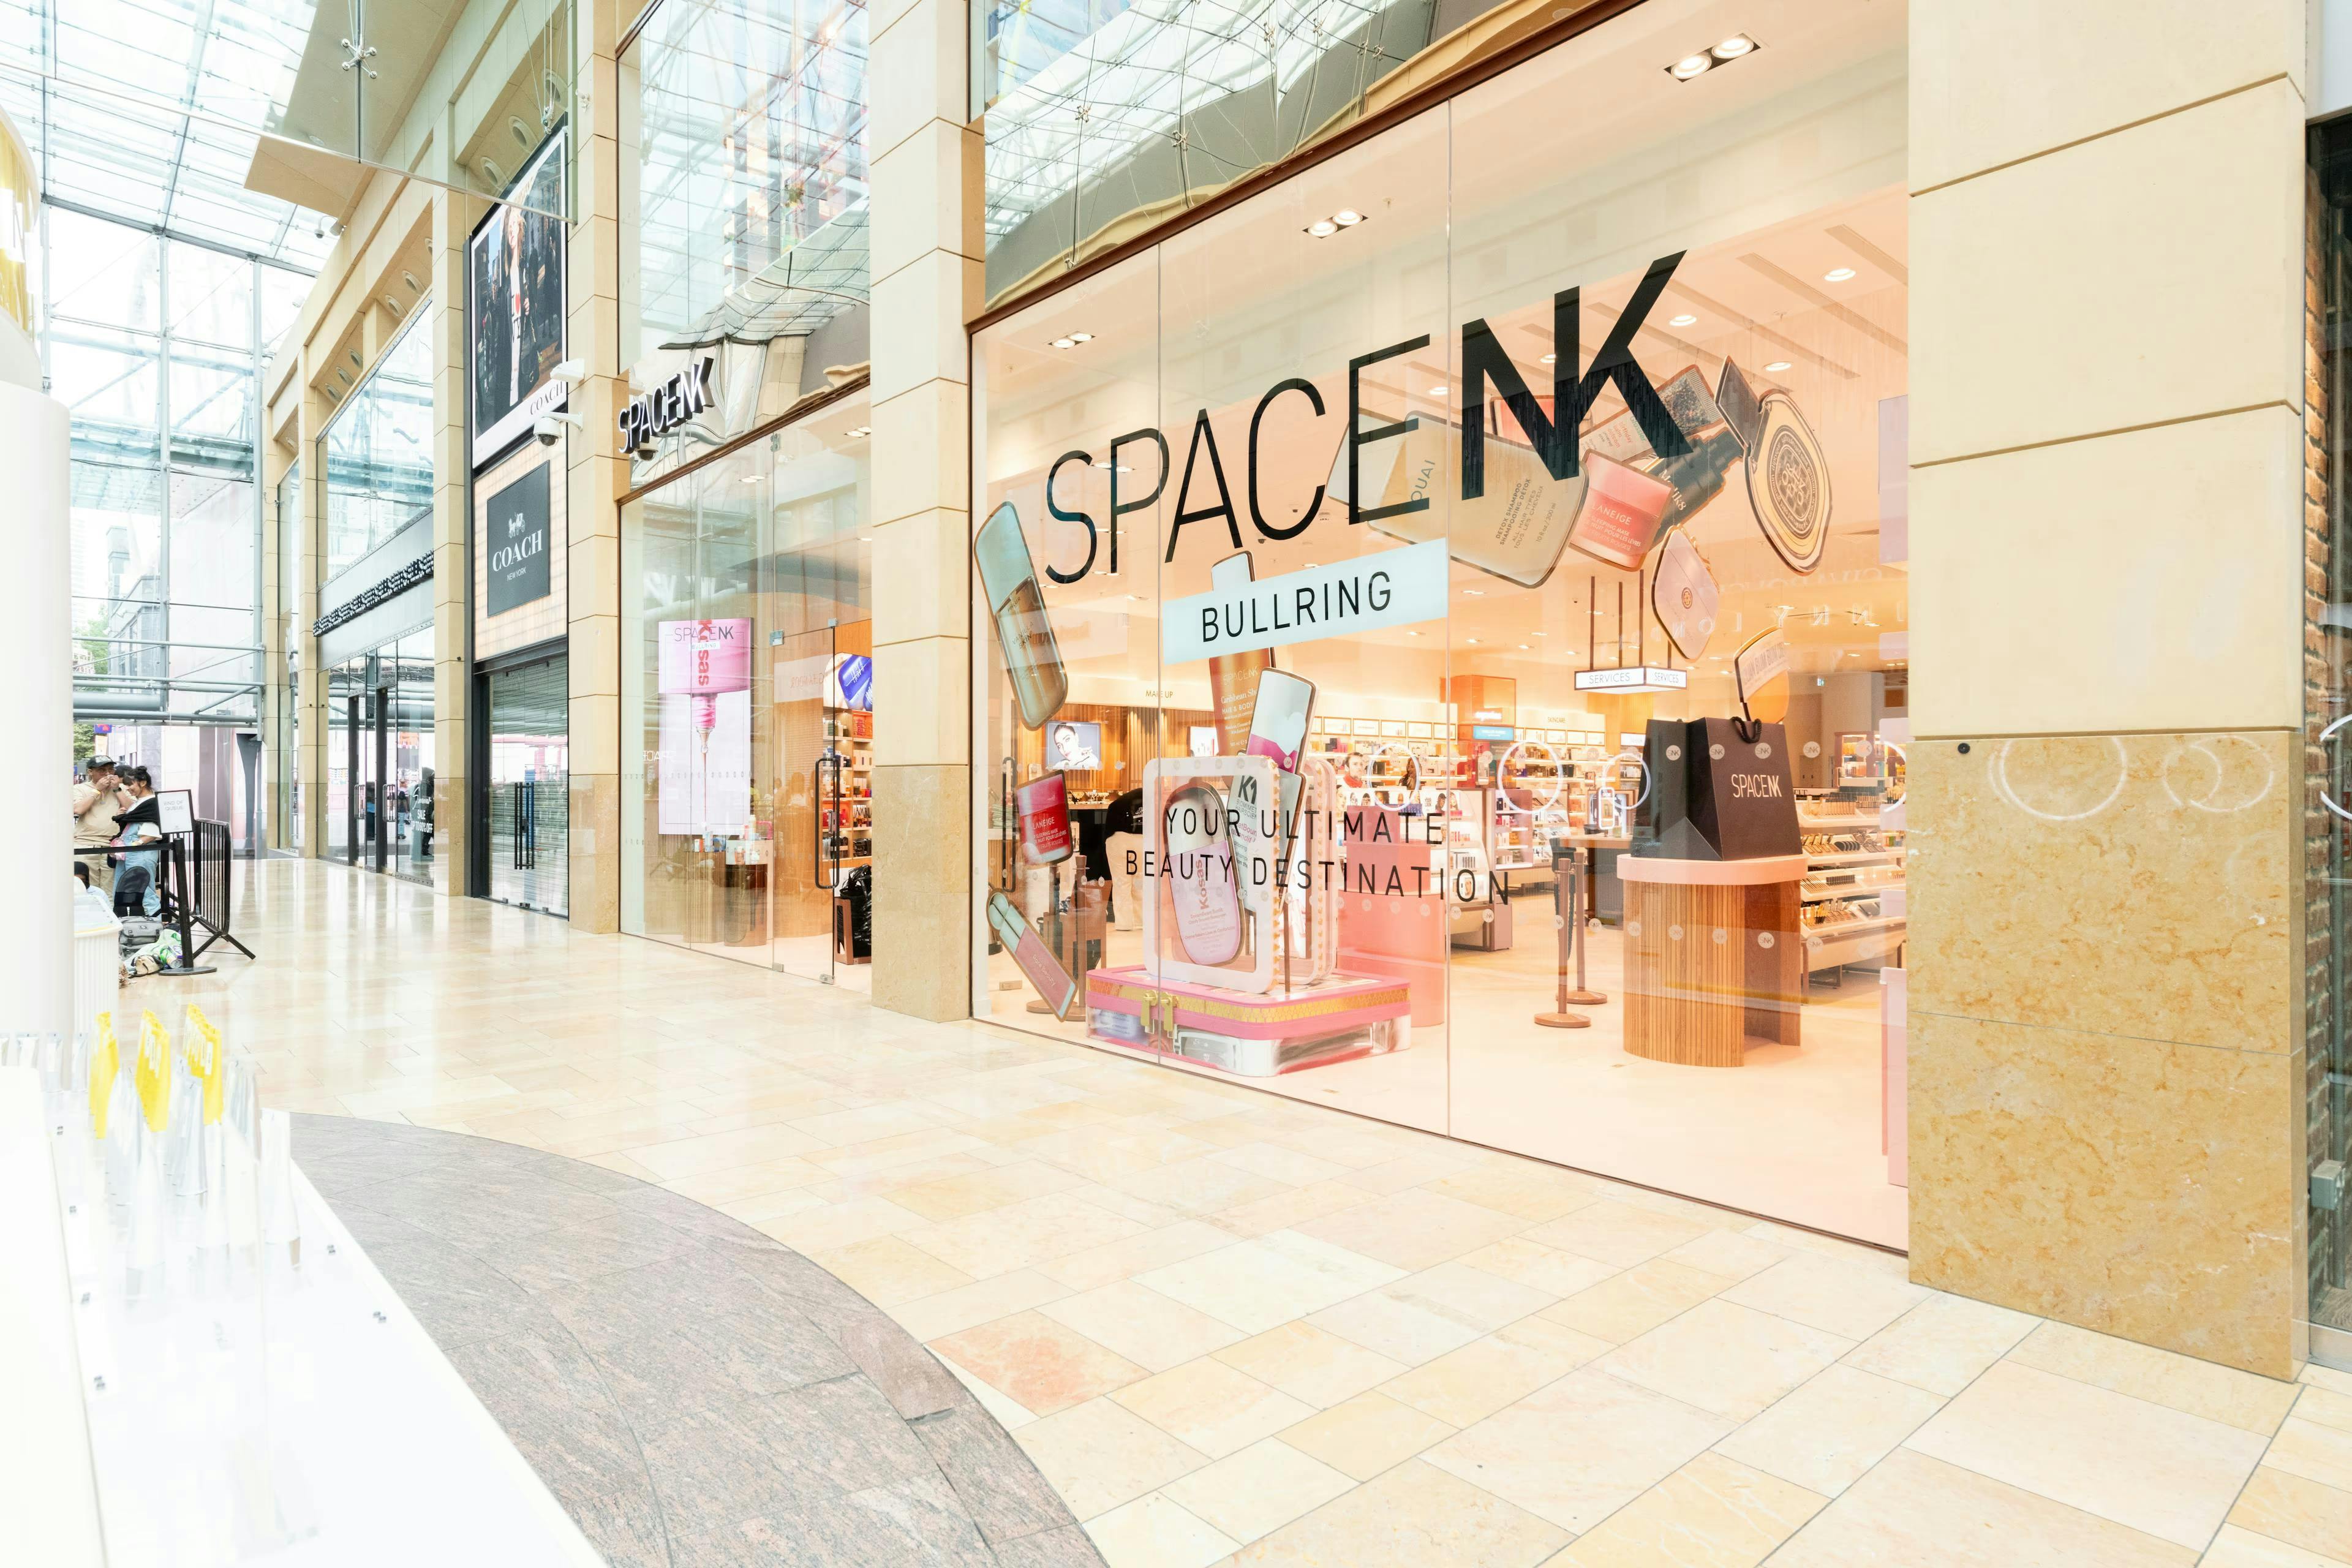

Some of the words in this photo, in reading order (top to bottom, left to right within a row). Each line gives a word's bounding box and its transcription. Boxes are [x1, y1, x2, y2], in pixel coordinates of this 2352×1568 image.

[530, 381, 563, 415] COACH
[619, 356, 710, 454] SPACENK
[1046, 250, 1693, 583] SPACENK
[1411, 459, 1435, 502] OUAI
[1496, 518, 1509, 539] DETOX
[1506, 483, 1522, 516] SHAMPOO
[1499, 502, 1522, 545] SHAMPOOING
[1513, 533, 1525, 549] TOUS
[1523, 518, 1532, 531] LES
[1529, 485, 1544, 516] CHEVEUX
[1519, 512, 1528, 528] HAIR
[1525, 490, 1537, 511] TYPES
[1593, 503, 1632, 526] LANEIGE
[492, 529, 543, 571] COACH
[507, 571, 516, 581] NEW
[516, 566, 527, 577] YORK
[1202, 571, 1392, 643] BULLRING
[1589, 673, 1630, 684] SERVICES
[1654, 672, 1679, 684] SERVICES
[1238, 701, 1254, 710] BODY
[1731, 774, 1782, 797] SPACENK
[417, 809, 426, 820] SALE
[1032, 816, 1055, 830] LANEIGE
[1166, 809, 1240, 839] YOUR
[1261, 810, 1443, 845] ULTIMATE
[1036, 829, 1051, 839] SLEEPING
[1126, 850, 1232, 883] BEAUTY
[1254, 857, 1508, 905] DESTINATION
[1196, 859, 1210, 910] Kosas
[1033, 954, 1041, 967] Rare
[1041, 966, 1056, 986] Beauty
